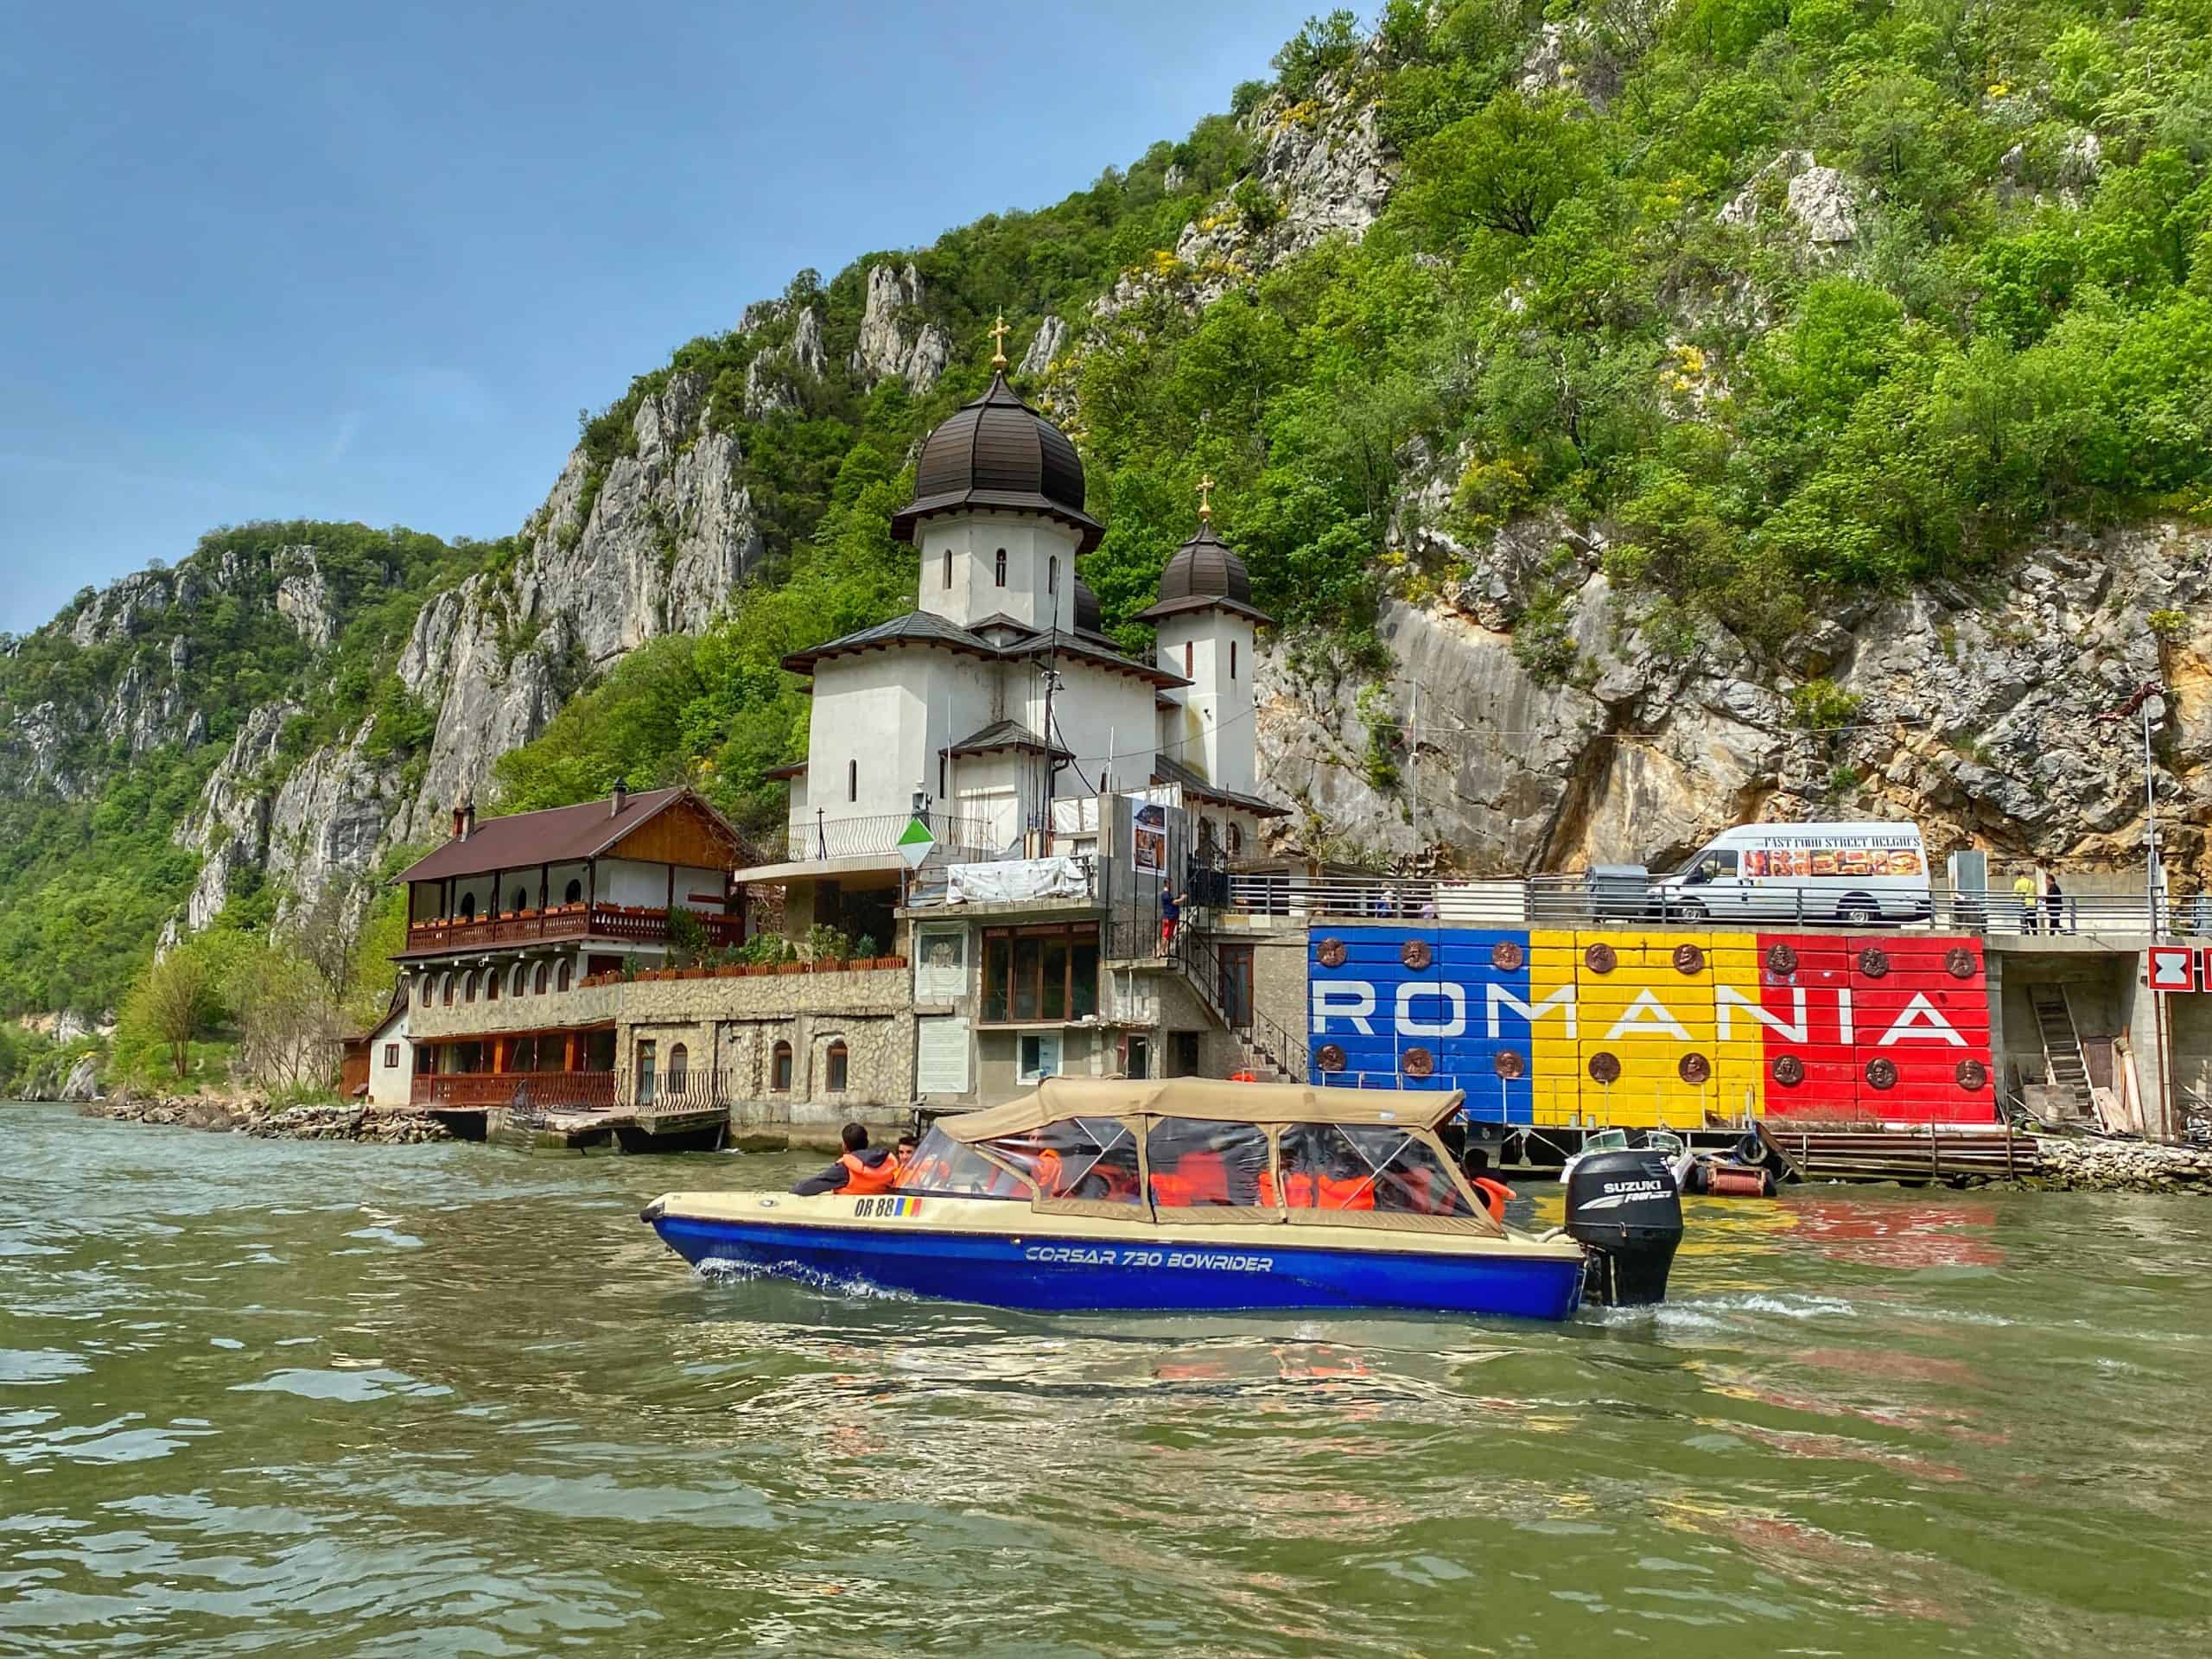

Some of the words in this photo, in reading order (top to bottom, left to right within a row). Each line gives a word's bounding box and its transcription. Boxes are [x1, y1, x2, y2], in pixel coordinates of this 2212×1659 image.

[1825, 836, 1868, 848] STREET
[1313, 980, 1967, 1046] ROMANIA
[1604, 1180, 1662, 1193] SUZUKI
[855, 1198, 874, 1217] OR
[876, 1198, 894, 1217] 88
[1026, 1247, 1116, 1265] CORSAR
[1122, 1251, 1162, 1267] 730
[1166, 1253, 1274, 1272] BOWRIDER
